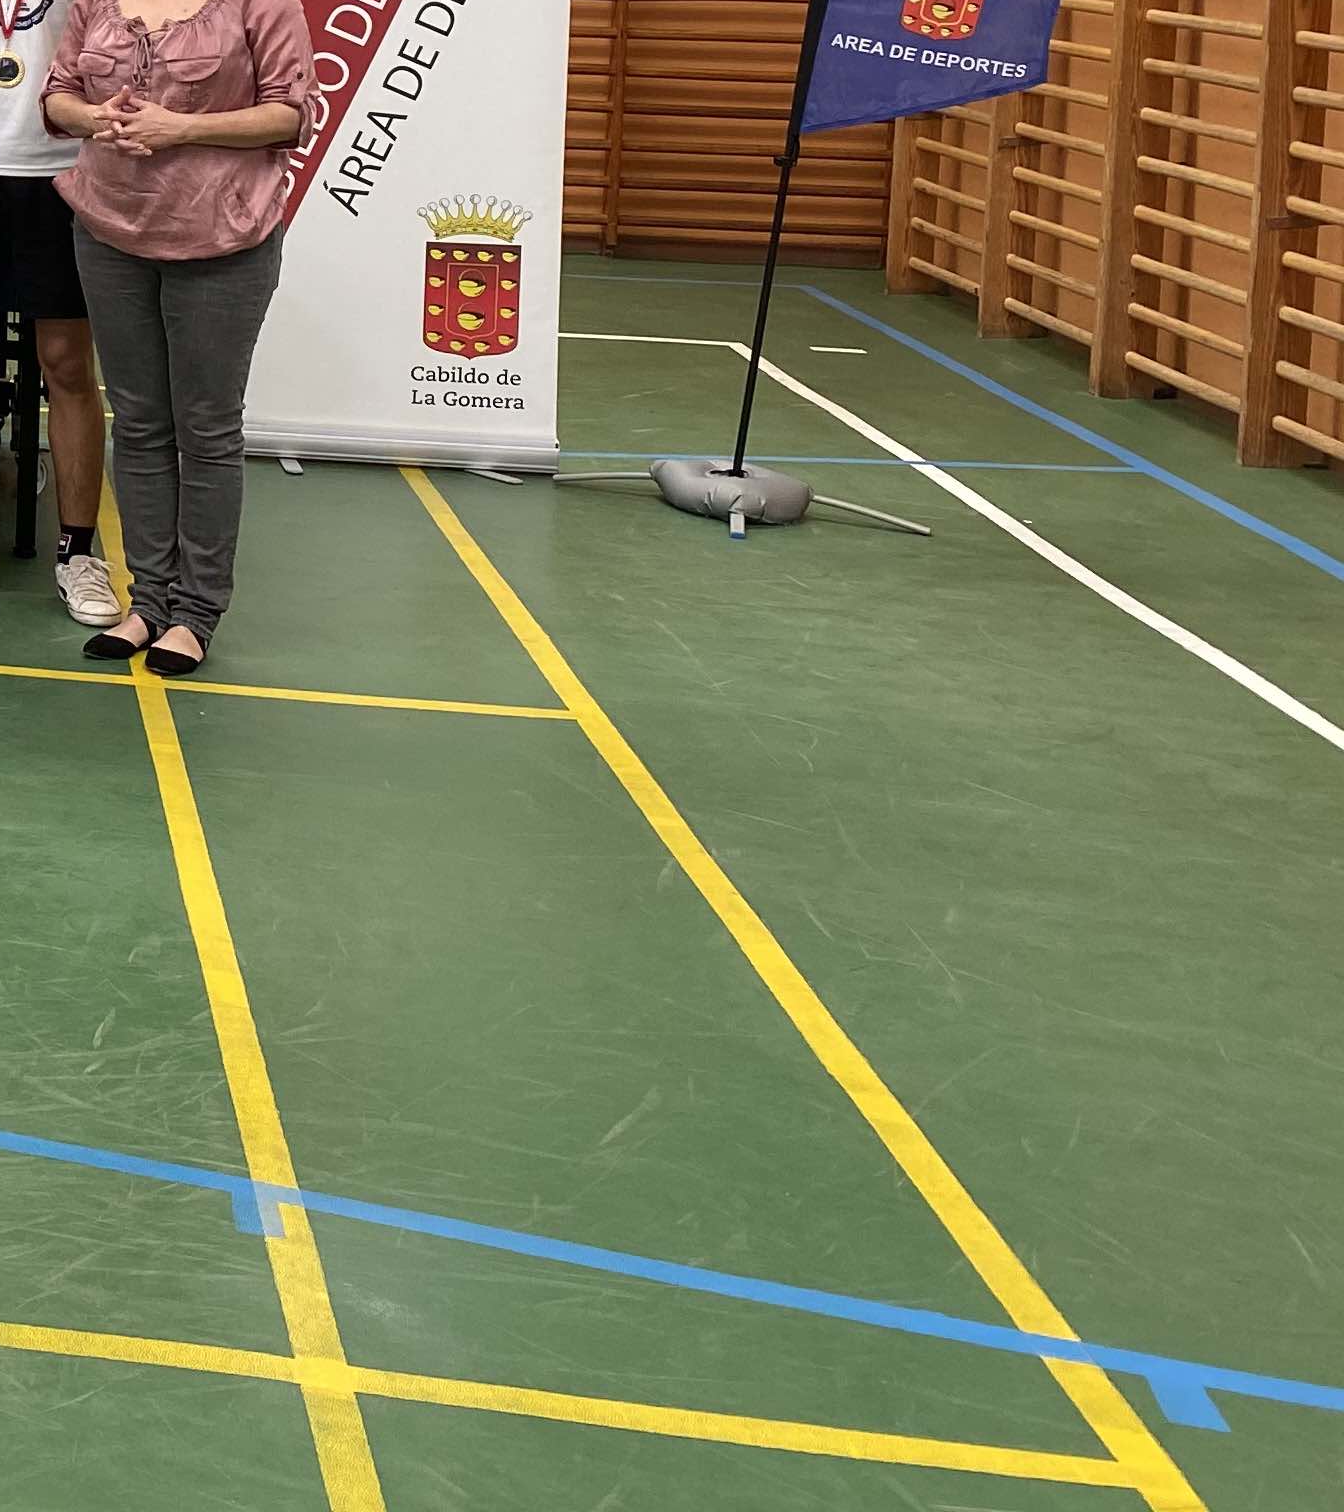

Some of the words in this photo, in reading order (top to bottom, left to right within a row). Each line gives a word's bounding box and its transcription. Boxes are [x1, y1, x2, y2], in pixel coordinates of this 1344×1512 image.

[831, 33, 884, 56] AREA
[889, 44, 917, 62] DE
[920, 50, 1027, 78] DEPORTES
[323, 112, 408, 216] ÁREA
[382, 39, 440, 101] DE
[411, 366, 490, 384] Cabildo
[496, 369, 521, 385] de
[411, 390, 435, 405] La
[443, 391, 525, 409] Gomera
